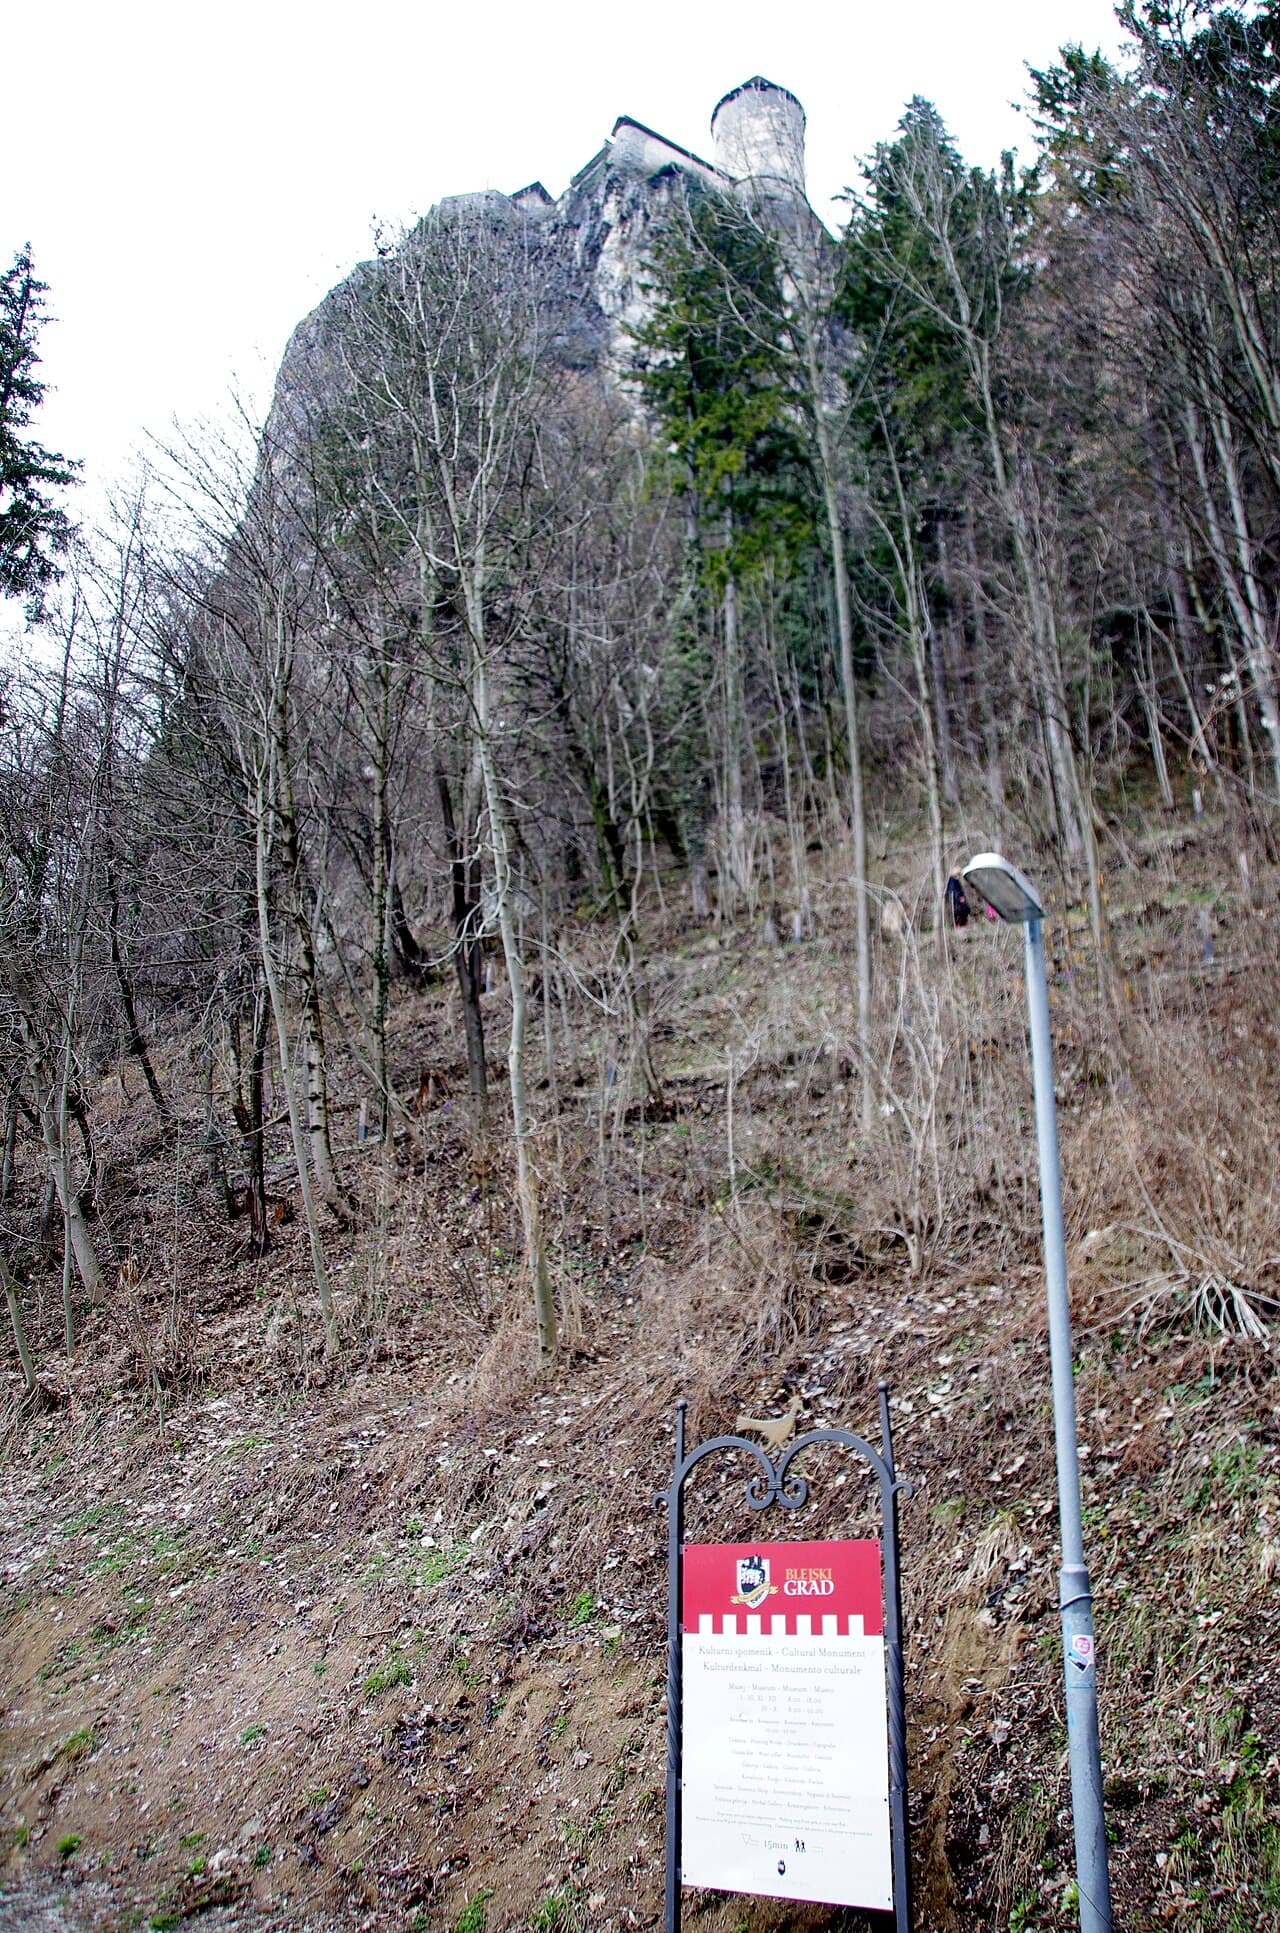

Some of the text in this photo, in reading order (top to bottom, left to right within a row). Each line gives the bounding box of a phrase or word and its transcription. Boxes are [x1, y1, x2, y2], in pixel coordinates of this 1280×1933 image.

[785, 1568, 832, 1581] BLEJSKI
[783, 1580, 835, 1596] GRAD
[698, 1647, 733, 1656] Kulturni
[735, 1647, 773, 1658] spomenik
[781, 1647, 816, 1657] Cultural
[818, 1648, 866, 1657] Monument
[703, 1661, 762, 1672] Kulturdenkmal
[771, 1664, 822, 1674] Monumento
[824, 1665, 862, 1675] culturale
